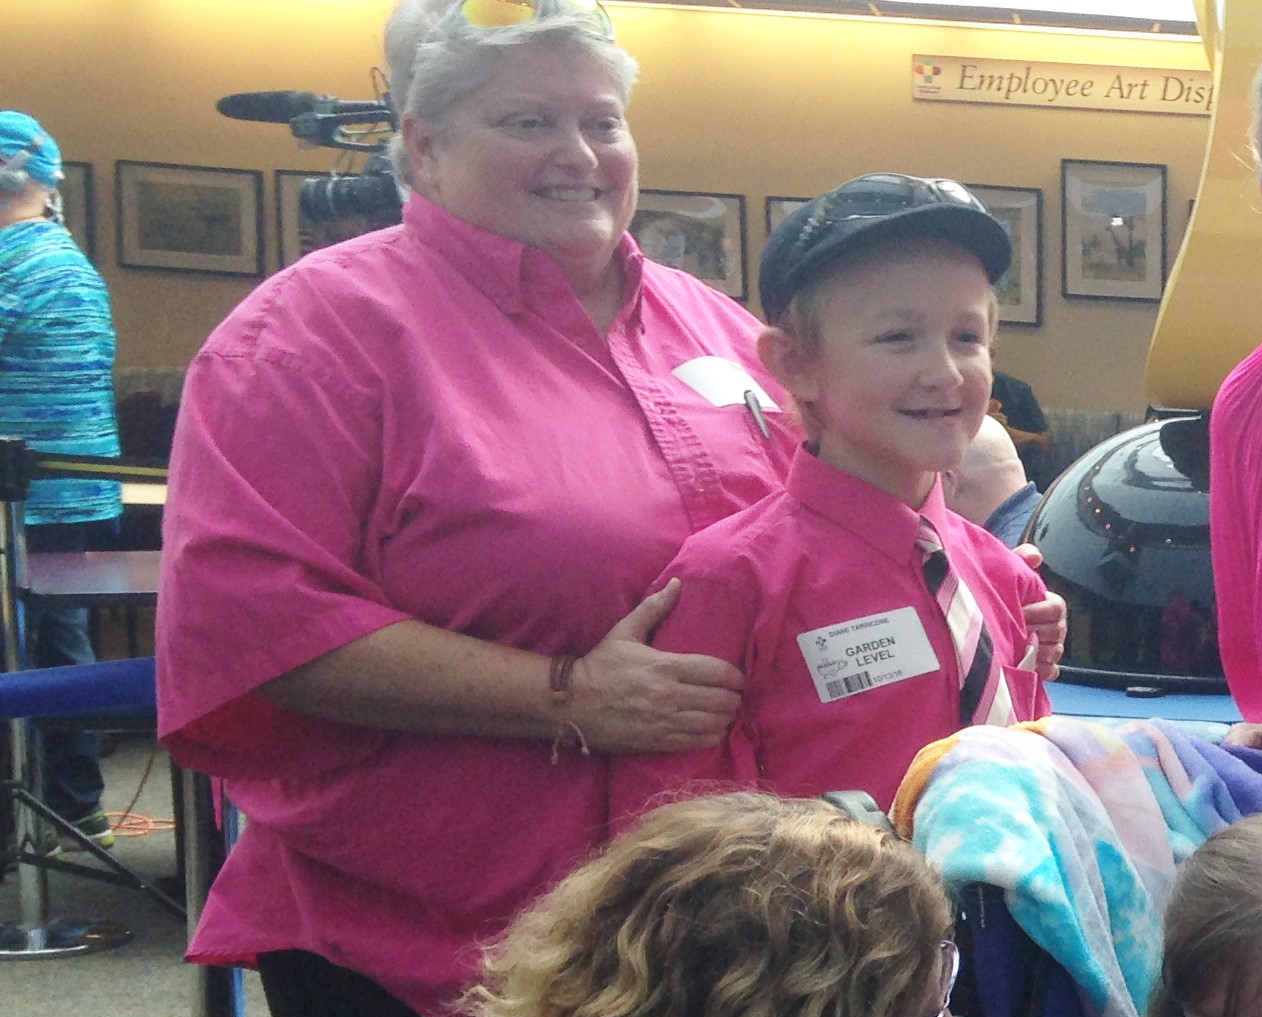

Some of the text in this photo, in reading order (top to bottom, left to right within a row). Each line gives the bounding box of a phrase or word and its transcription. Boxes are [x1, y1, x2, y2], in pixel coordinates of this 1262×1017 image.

[956, 64, 1093, 101] Employee
[1104, 73, 1150, 100] Art
[845, 635, 896, 657] GARDEN
[855, 649, 895, 667] LEVEL
